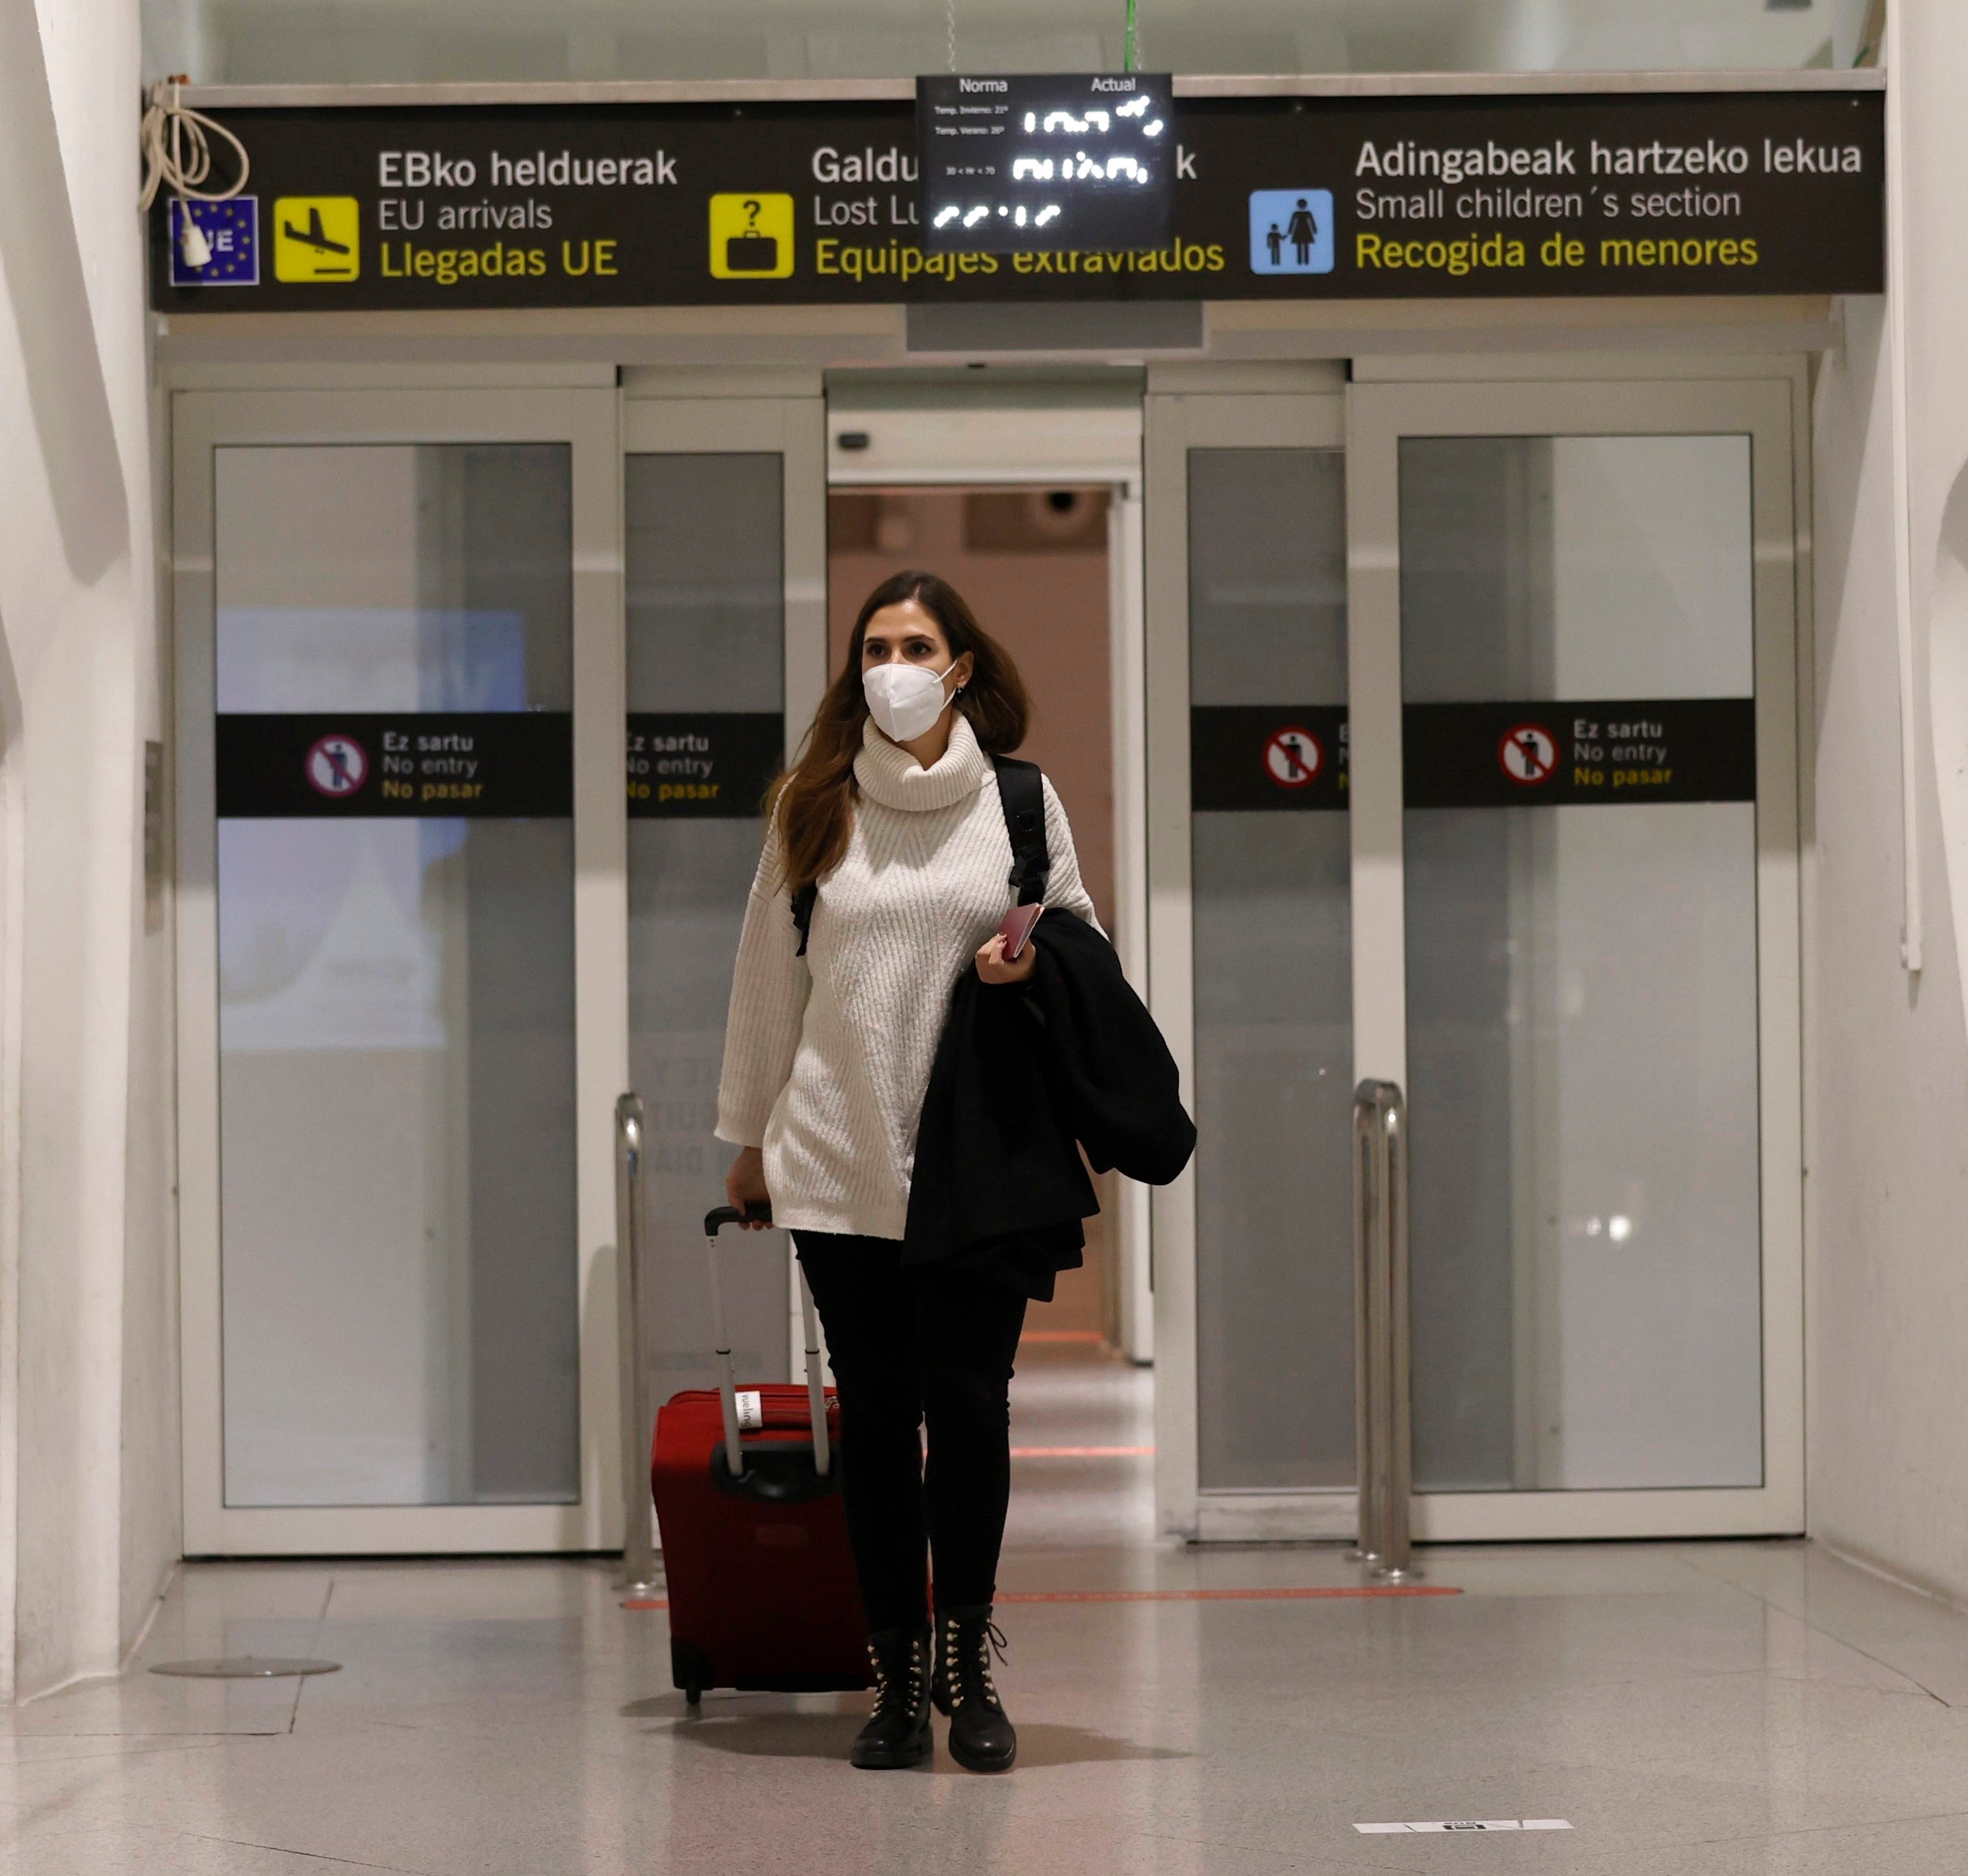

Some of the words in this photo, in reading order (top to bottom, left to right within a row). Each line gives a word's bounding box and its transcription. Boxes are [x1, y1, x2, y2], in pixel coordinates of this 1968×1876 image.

[959, 78, 1008, 93] Norma
[1090, 77, 1137, 92] Actual
[378, 151, 477, 188] EBko
[491, 149, 678, 187] helduerak
[811, 146, 919, 184] Galdu
[1355, 140, 1577, 185] Adingabeak
[1590, 138, 1749, 175] hartzeko
[1763, 137, 1862, 174] lekua
[378, 199, 425, 231] EU
[437, 198, 553, 230] arrivals
[813, 194, 878, 226] Lost
[1355, 188, 1444, 220] Small
[1630, 186, 1741, 218] section
[380, 240, 547, 286] Llegadas
[562, 239, 619, 276] UE
[816, 238, 999, 283] Equipajes
[1012, 236, 1225, 274] extraviados
[1356, 232, 1525, 276] Recogida
[1540, 231, 1585, 267] de
[1600, 238, 1758, 267] menores
[1573, 718, 1599, 739] Ez
[1607, 720, 1663, 739] sartu
[383, 731, 410, 751] Ez
[417, 733, 474, 751] sartu
[652, 734, 709, 752] sartu
[383, 754, 414, 775] No
[421, 757, 478, 778] entry
[1573, 743, 1604, 762] No
[1611, 744, 1667, 765] entry
[657, 757, 713, 779] entry
[1573, 767, 1605, 786] No
[1613, 768, 1671, 789] pasar
[383, 779, 414, 799] No
[422, 783, 484, 801] pasar
[658, 783, 720, 803] pasar
[741, 1393, 754, 1428] vueling
